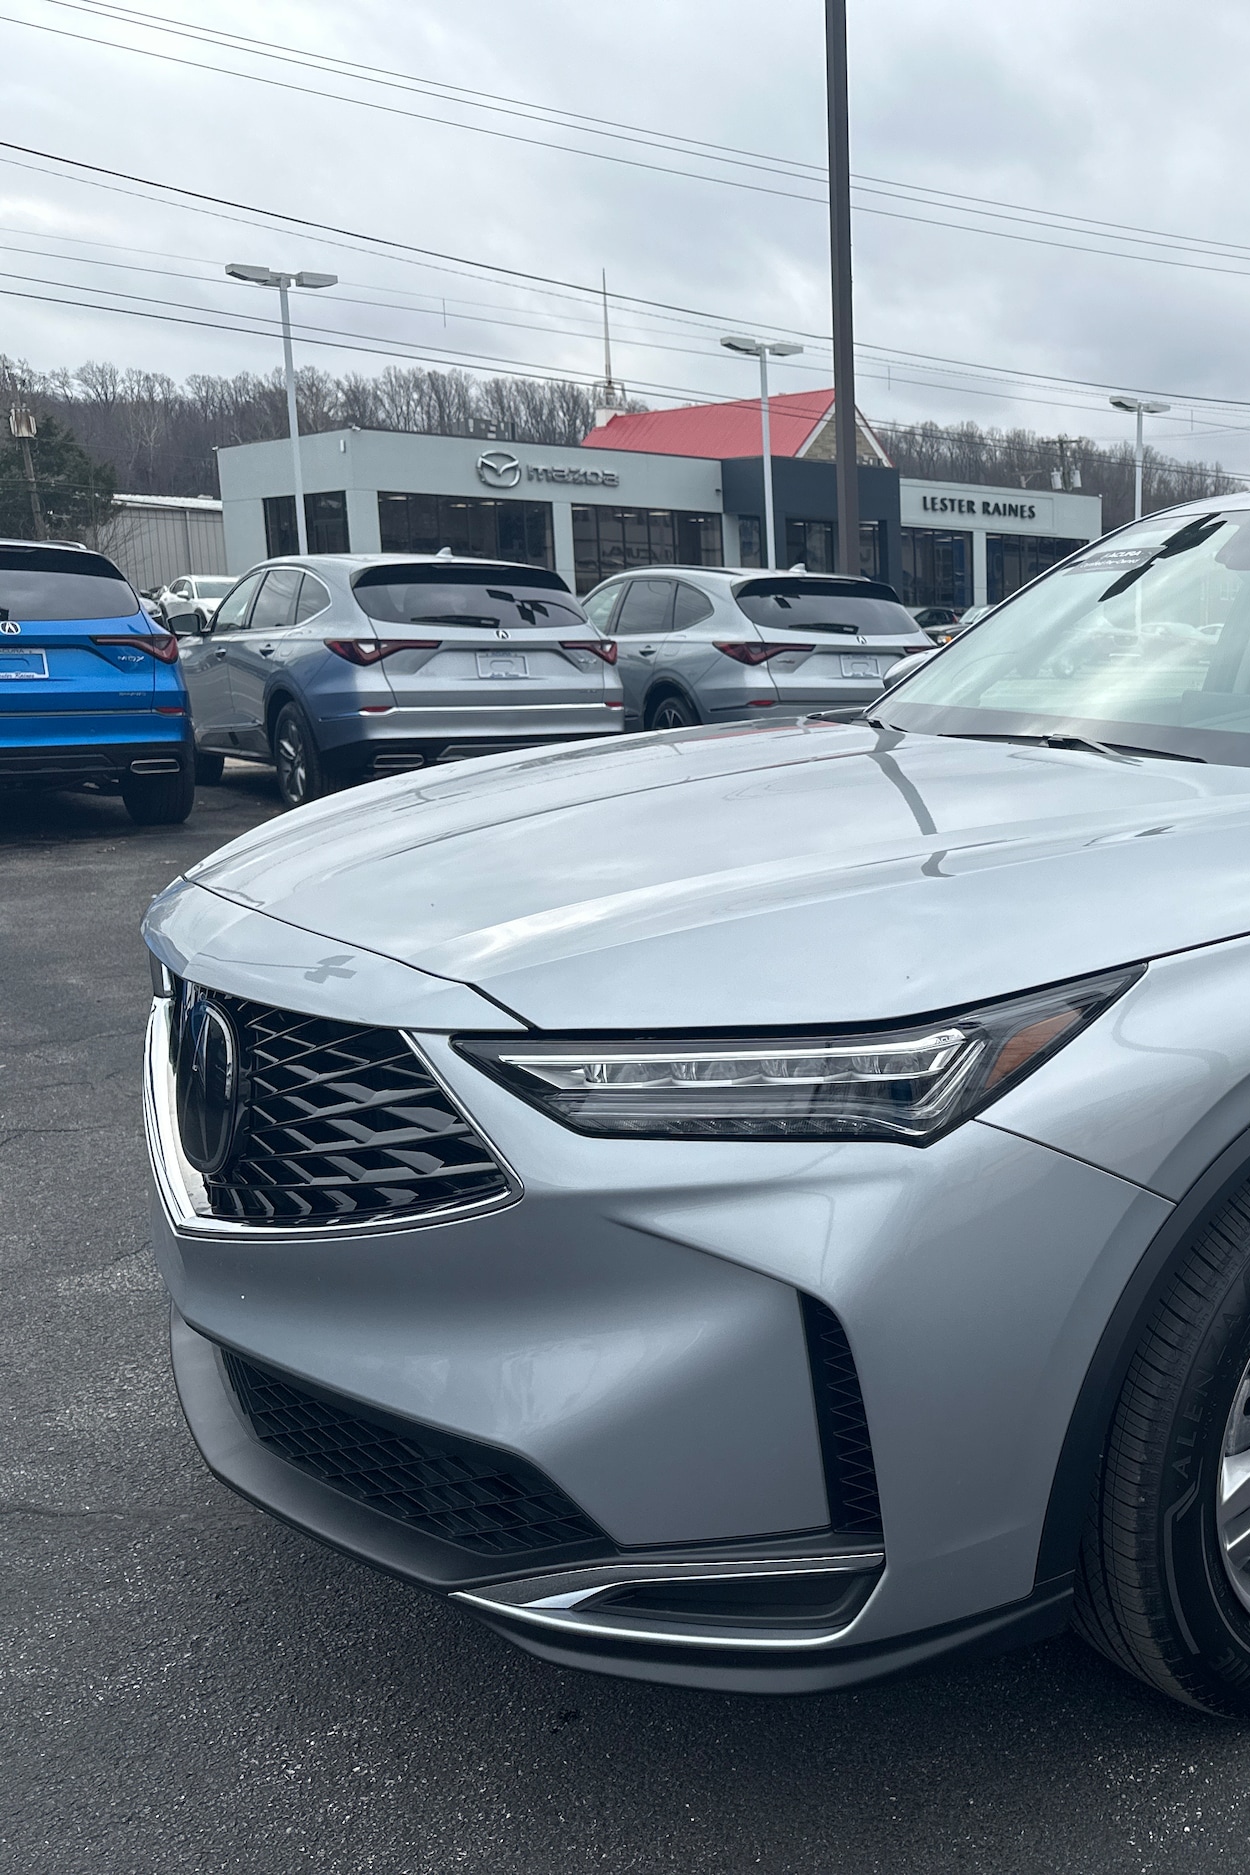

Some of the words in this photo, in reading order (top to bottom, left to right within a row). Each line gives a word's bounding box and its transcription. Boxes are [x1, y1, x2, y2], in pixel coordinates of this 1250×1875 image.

[922, 496, 976, 515] LESTER
[982, 501, 1036, 519] RAINES
[1172, 1312, 1242, 1480] ALENZA
